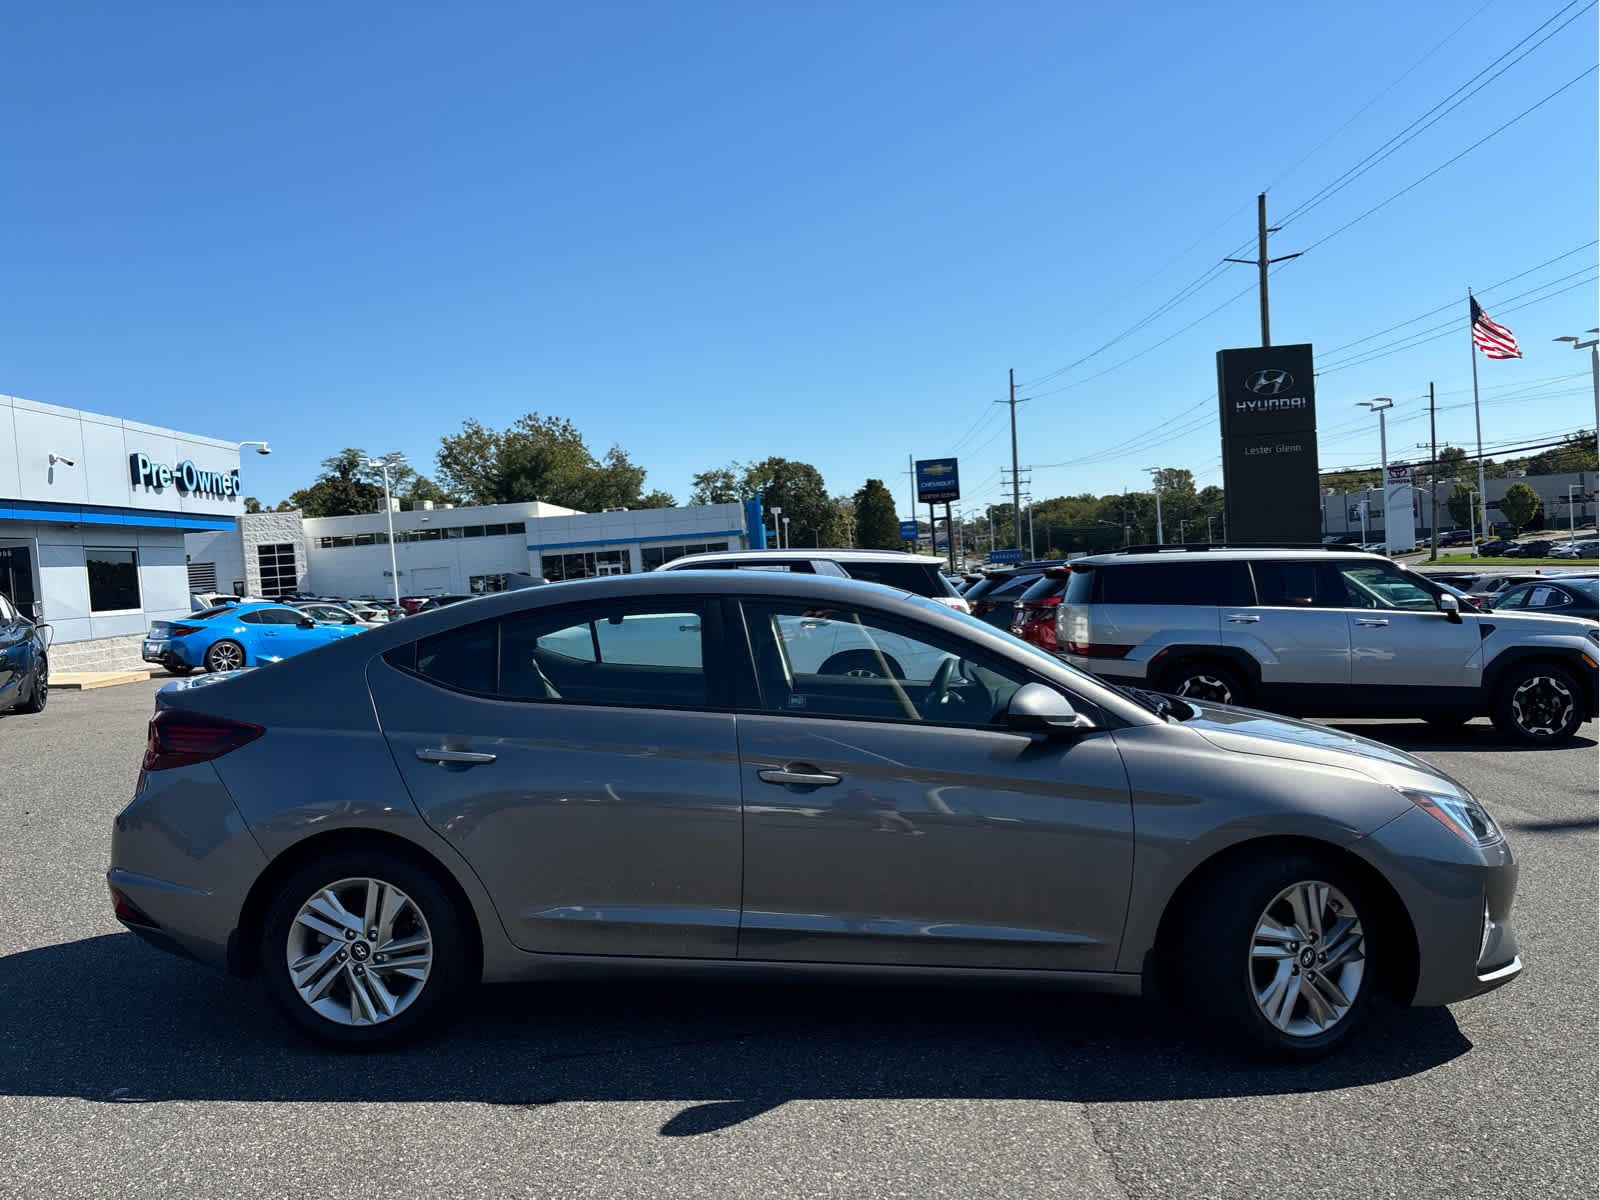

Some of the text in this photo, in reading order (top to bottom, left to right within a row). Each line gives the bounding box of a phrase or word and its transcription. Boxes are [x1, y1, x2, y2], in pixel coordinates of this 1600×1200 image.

[1236, 398, 1306, 412] HYUNDAI
[1244, 443, 1302, 455] Lester Glenn
[132, 453, 241, 496] Pre-Owned
